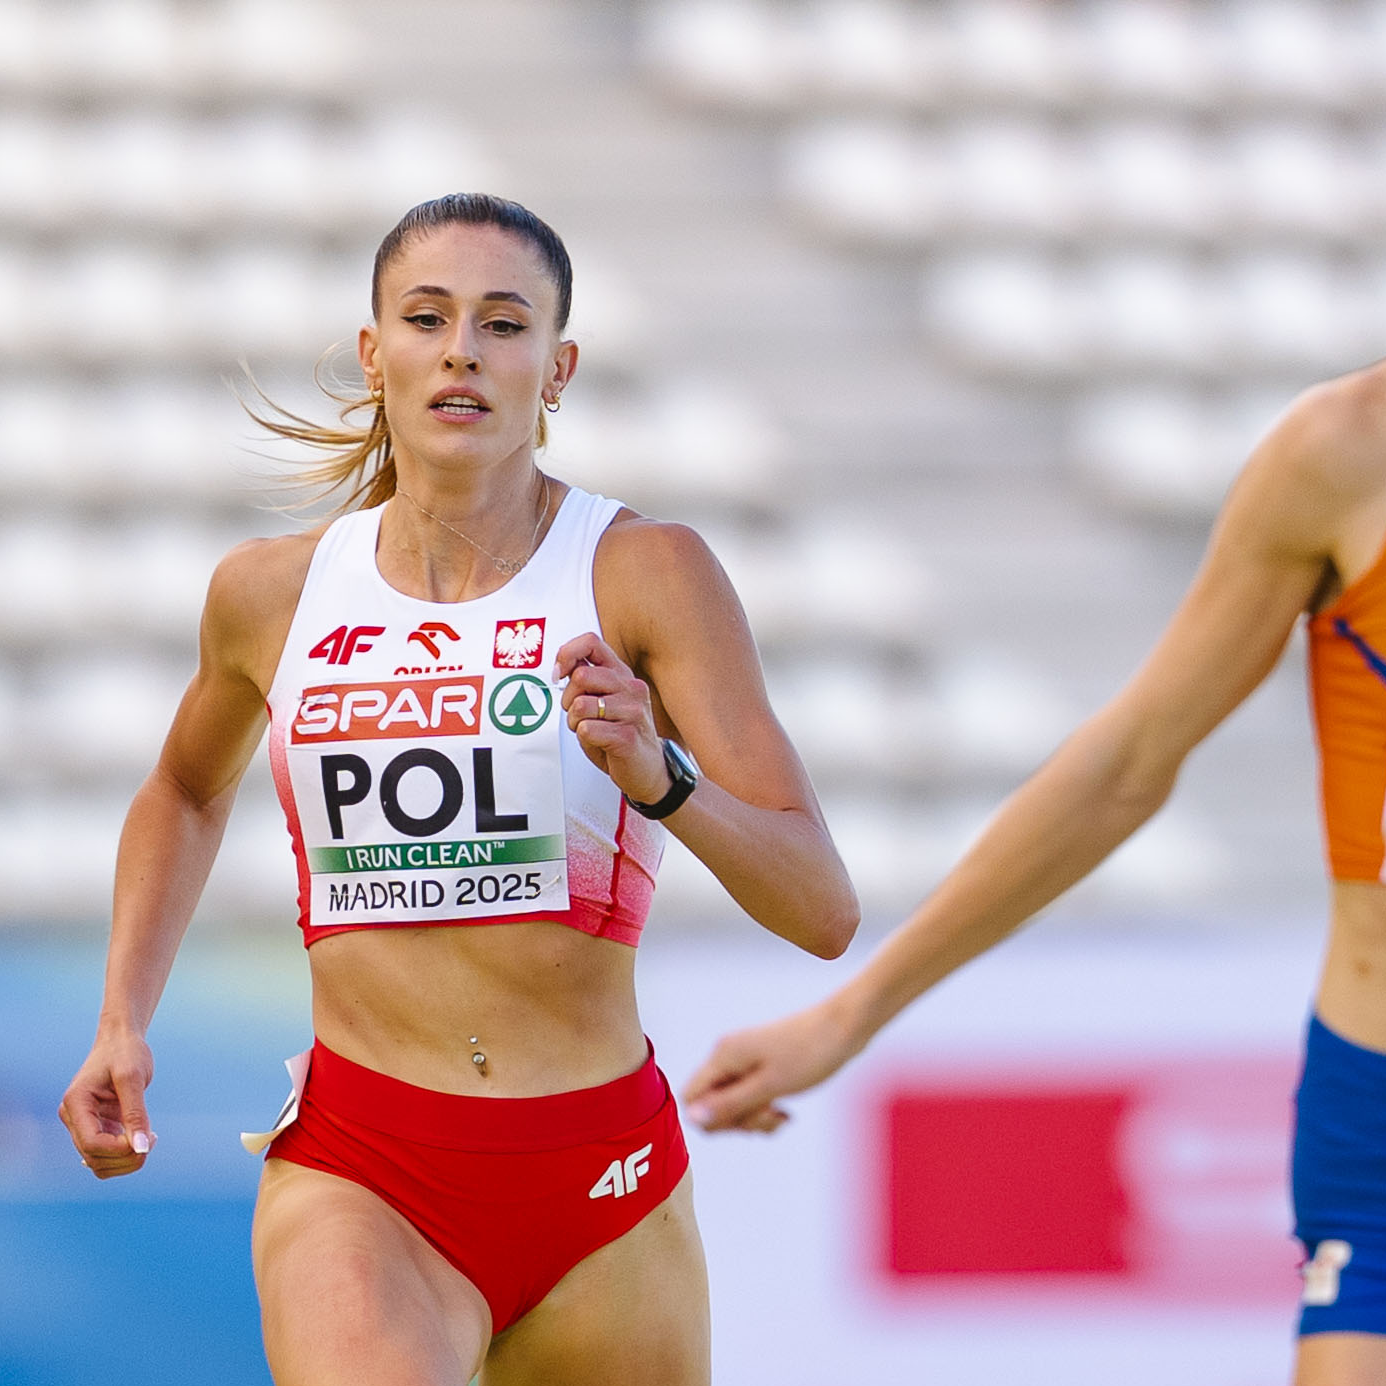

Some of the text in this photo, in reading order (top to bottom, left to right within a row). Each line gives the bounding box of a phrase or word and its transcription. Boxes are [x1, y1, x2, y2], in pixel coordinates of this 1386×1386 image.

[308, 625, 386, 665] 4F
[295, 685, 478, 735] SPAR
[320, 747, 528, 839] POL
[346, 850, 354, 868] I
[356, 847, 402, 868] RUN
[329, 873, 542, 912] MADRID 2025
[588, 1143, 653, 1199] 4F
